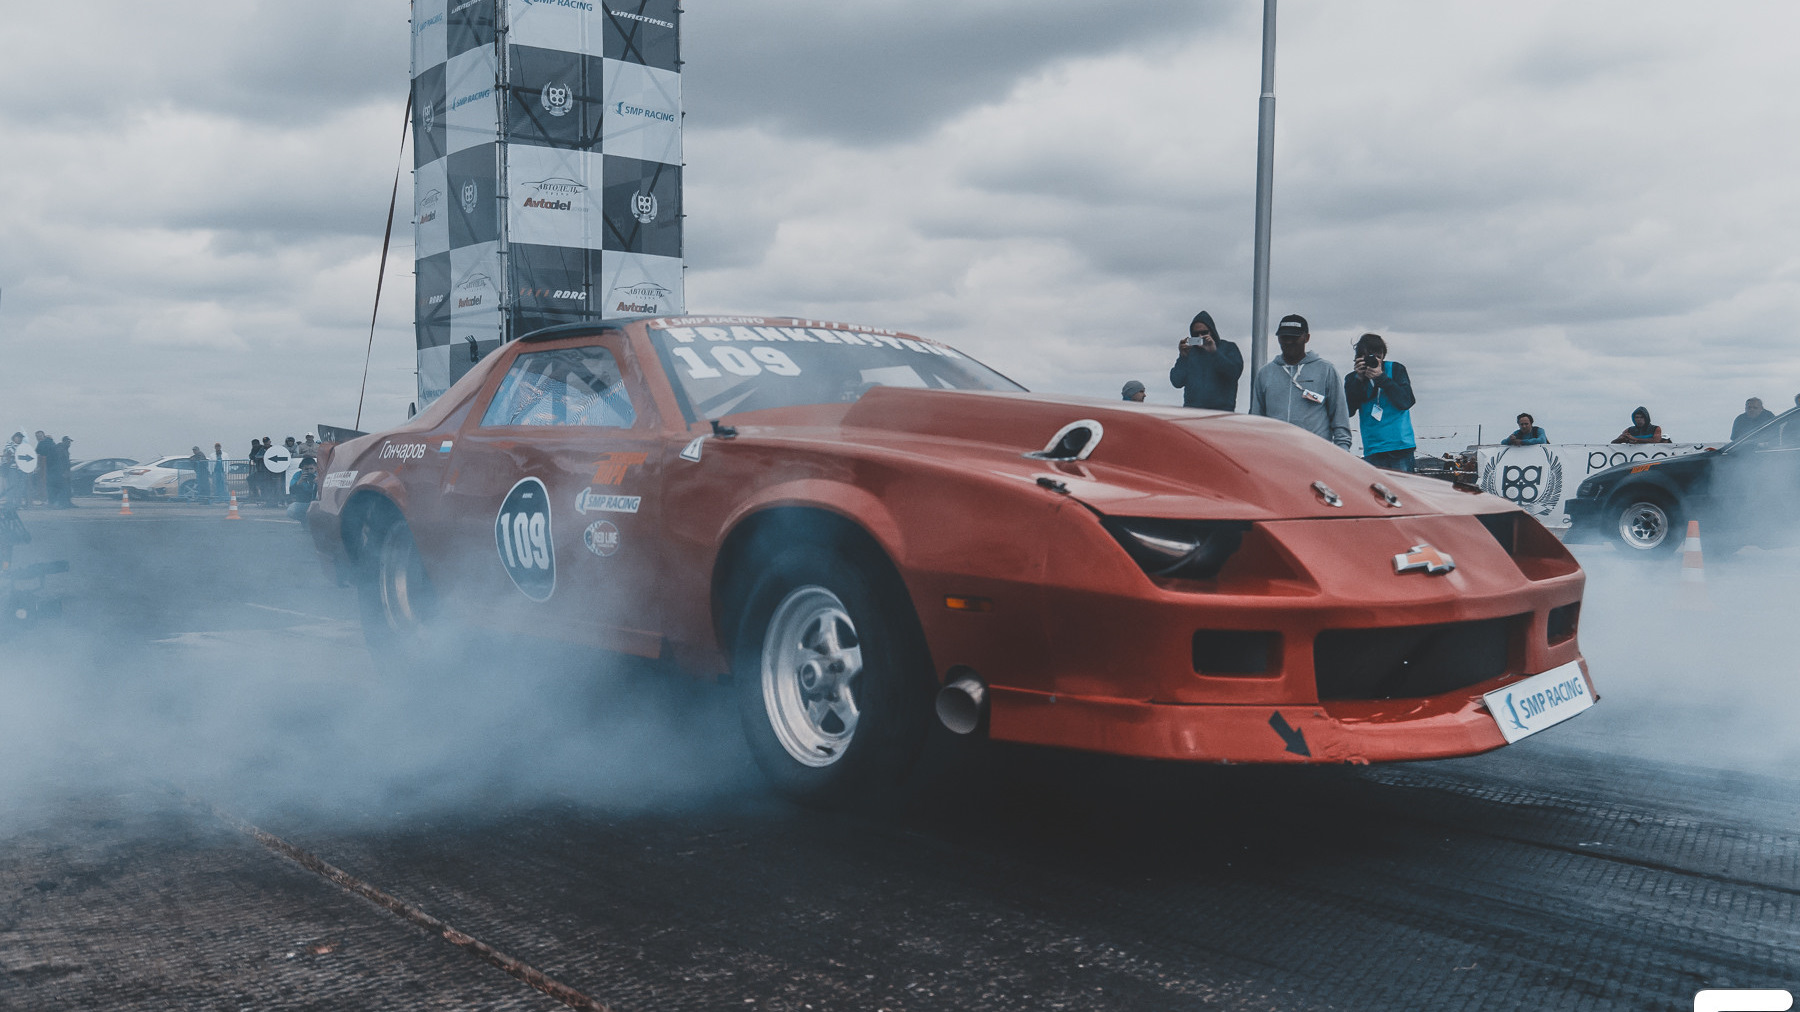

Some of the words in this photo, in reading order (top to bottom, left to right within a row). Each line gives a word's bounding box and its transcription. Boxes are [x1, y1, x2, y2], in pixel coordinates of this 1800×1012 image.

[557, 0, 593, 12] RACING
[456, 97, 468, 107] SMP
[468, 89, 490, 103] RACING
[625, 105, 643, 116] SMP
[644, 109, 674, 122] RACING
[553, 289, 587, 300] RDRC
[616, 301, 658, 314] Avtodel
[671, 316, 706, 326] SMP
[708, 316, 765, 325] RACING
[665, 325, 962, 360] FRANKENSTEIN
[672, 345, 802, 380] 109
[378, 440, 427, 463] Гончаров
[587, 495, 606, 508] SMP
[606, 496, 640, 511] RACING
[500, 511, 550, 570] 109
[1519, 692, 1546, 720] SMP
[1545, 676, 1584, 709] RACING
